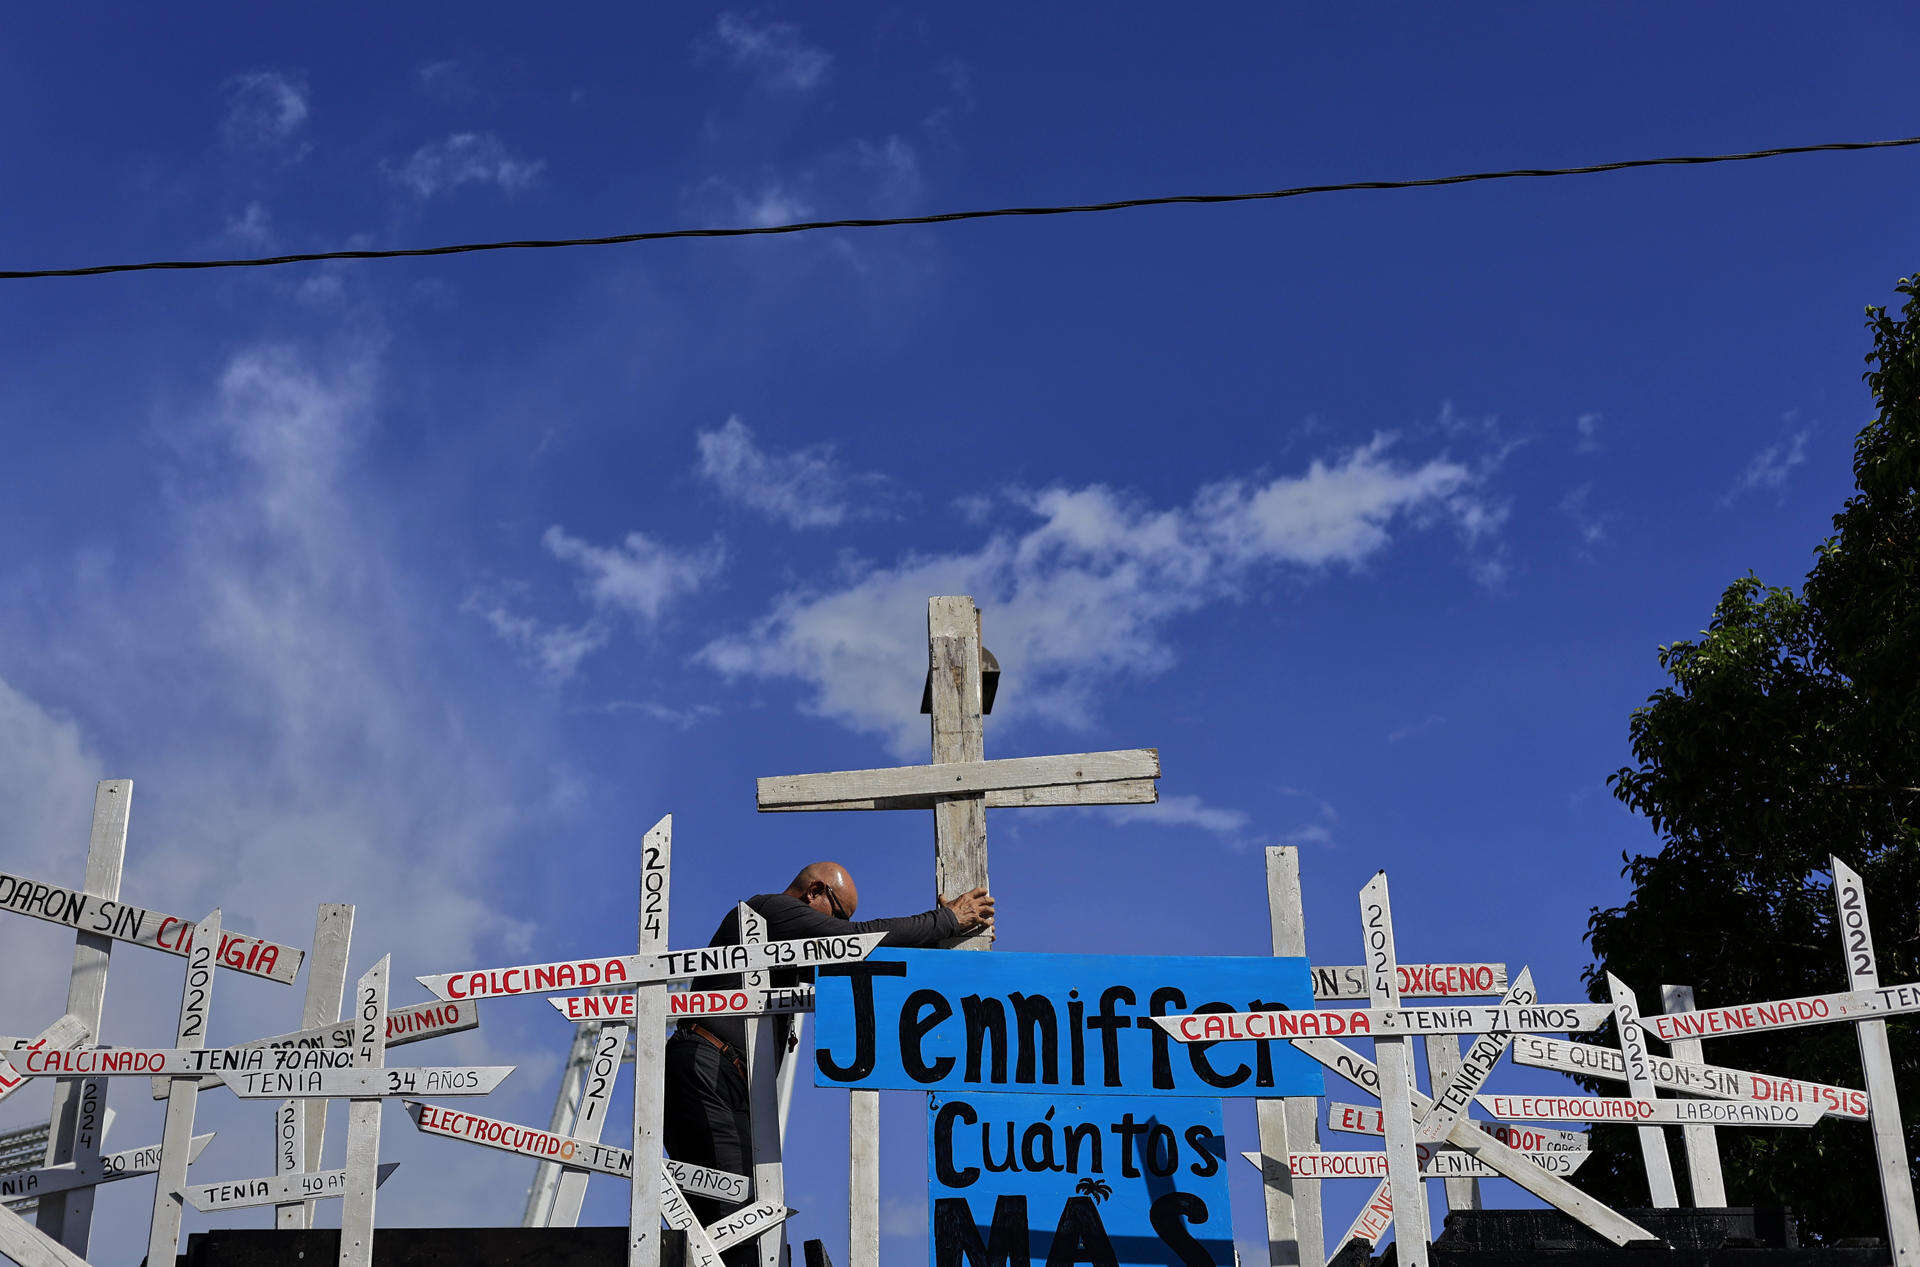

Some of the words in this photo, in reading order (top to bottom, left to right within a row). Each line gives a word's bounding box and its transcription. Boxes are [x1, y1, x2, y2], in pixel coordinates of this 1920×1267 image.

[644, 847, 665, 939] 2024
[93, 902, 145, 939] SIN
[157, 917, 279, 974] CIGÍA
[1368, 904, 1390, 999] 2024
[1843, 886, 1873, 976] 2022
[182, 947, 210, 1037] 2022
[447, 960, 627, 999] CALCINADA
[657, 946, 749, 975] TENÍA
[763, 942, 796, 964] 93
[803, 937, 863, 962] AÑOS
[1345, 968, 1367, 995] SI
[360, 988, 377, 1062] 2024
[816, 960, 1291, 1089] Jenniffer
[1180, 1011, 1371, 1040] CALCINADA
[1397, 1008, 1473, 1030] TENÍA
[1485, 1010, 1509, 1030] 71
[1518, 1007, 1580, 1029] AÑOS
[1619, 1004, 1648, 1081] 2022
[1656, 998, 1829, 1040] ENVENENADO
[27, 1050, 166, 1073] CALCINADO
[190, 1048, 263, 1071] TENÍA
[274, 1050, 301, 1070] 70
[241, 1070, 322, 1093] TENÍA
[388, 1071, 416, 1091] 34
[426, 1070, 479, 1091] AÑOS
[586, 1036, 618, 1121] 2021
[1471, 1041, 1500, 1069] 50
[1528, 1040, 1559, 1062] SE
[1703, 1069, 1739, 1095] SIN
[80, 1083, 97, 1149] 2024
[283, 1107, 296, 1170] 2023
[1494, 1098, 1652, 1118] ELECTROCUTADO
[1676, 1102, 1799, 1121] LABORANDO
[101, 1155, 125, 1175] 30
[417, 1107, 576, 1160] ELECTROCUTADO
[690, 1169, 744, 1197] AÑOS
[1433, 1153, 1482, 1173] ENÍA
[204, 1179, 269, 1203] TENÍA
[302, 1177, 323, 1191] 40
